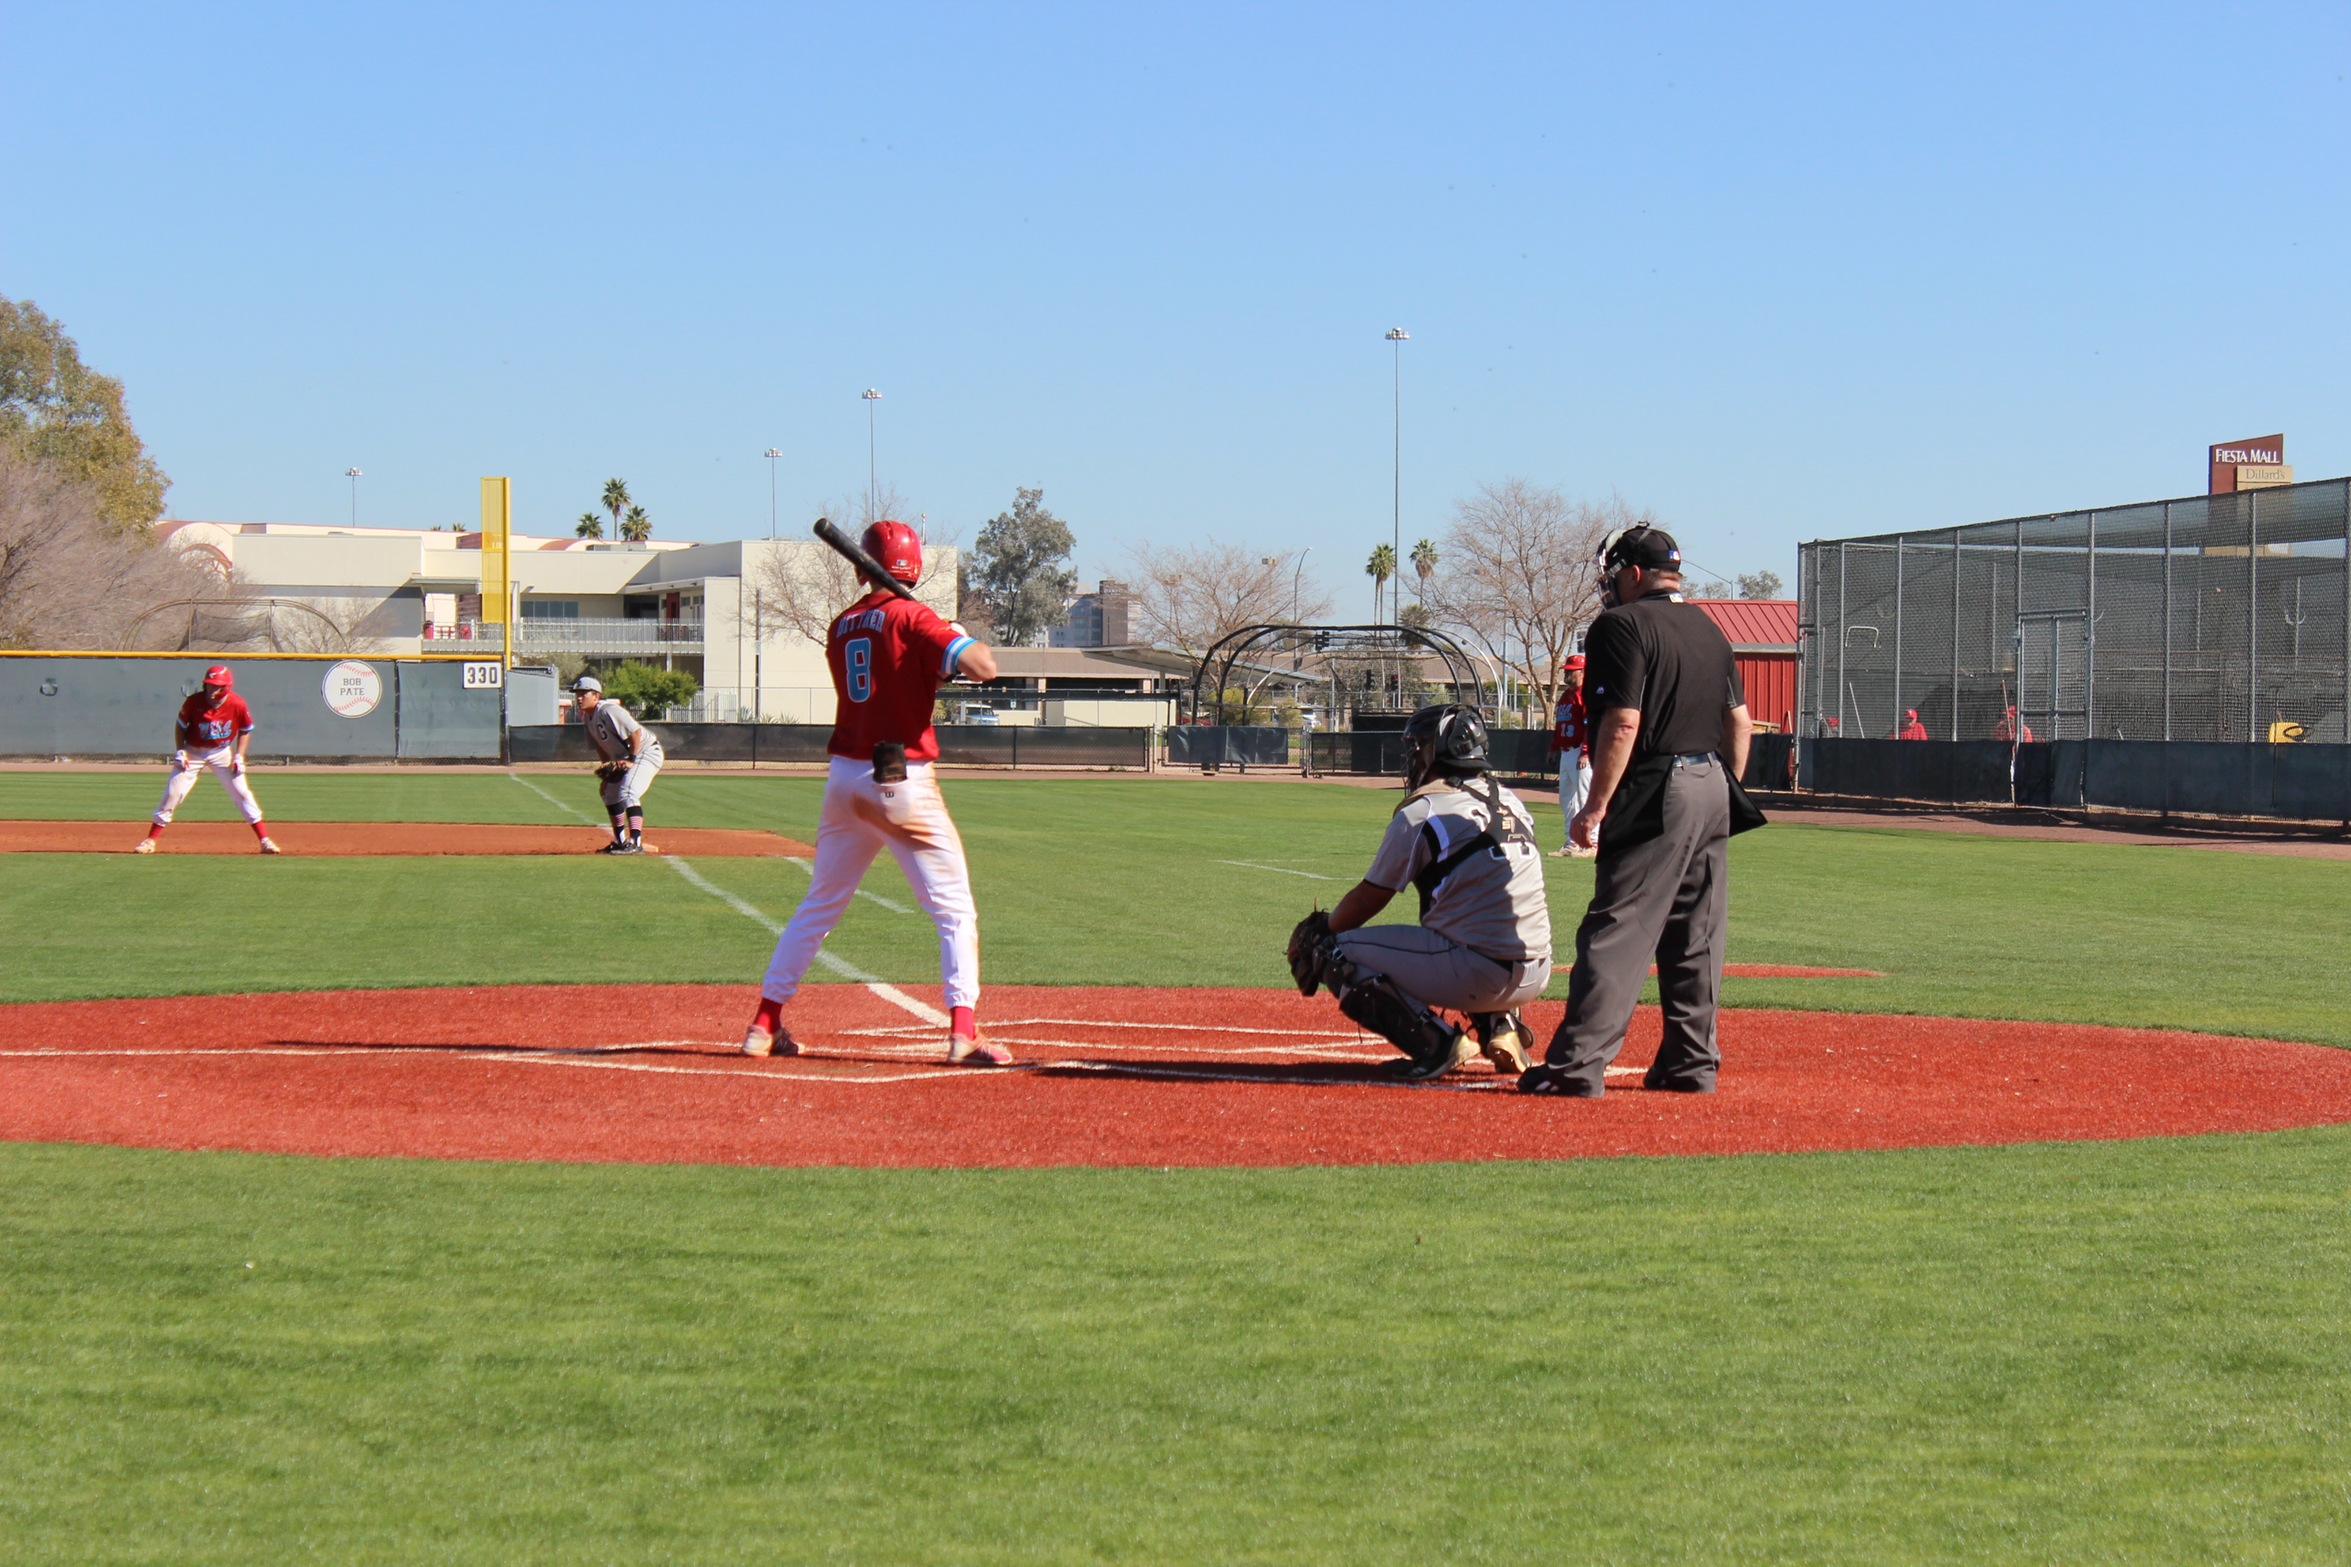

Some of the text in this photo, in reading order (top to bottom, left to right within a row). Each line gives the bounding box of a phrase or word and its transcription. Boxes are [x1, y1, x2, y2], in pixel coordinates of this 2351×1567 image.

[2215, 448, 2280, 463] FIESTA MALL
[2245, 468, 2286, 480] Dillard's
[467, 666, 498, 684] 330
[845, 637, 871, 703] 8
[343, 677, 362, 686] BOB
[339, 687, 365, 696] PATE
